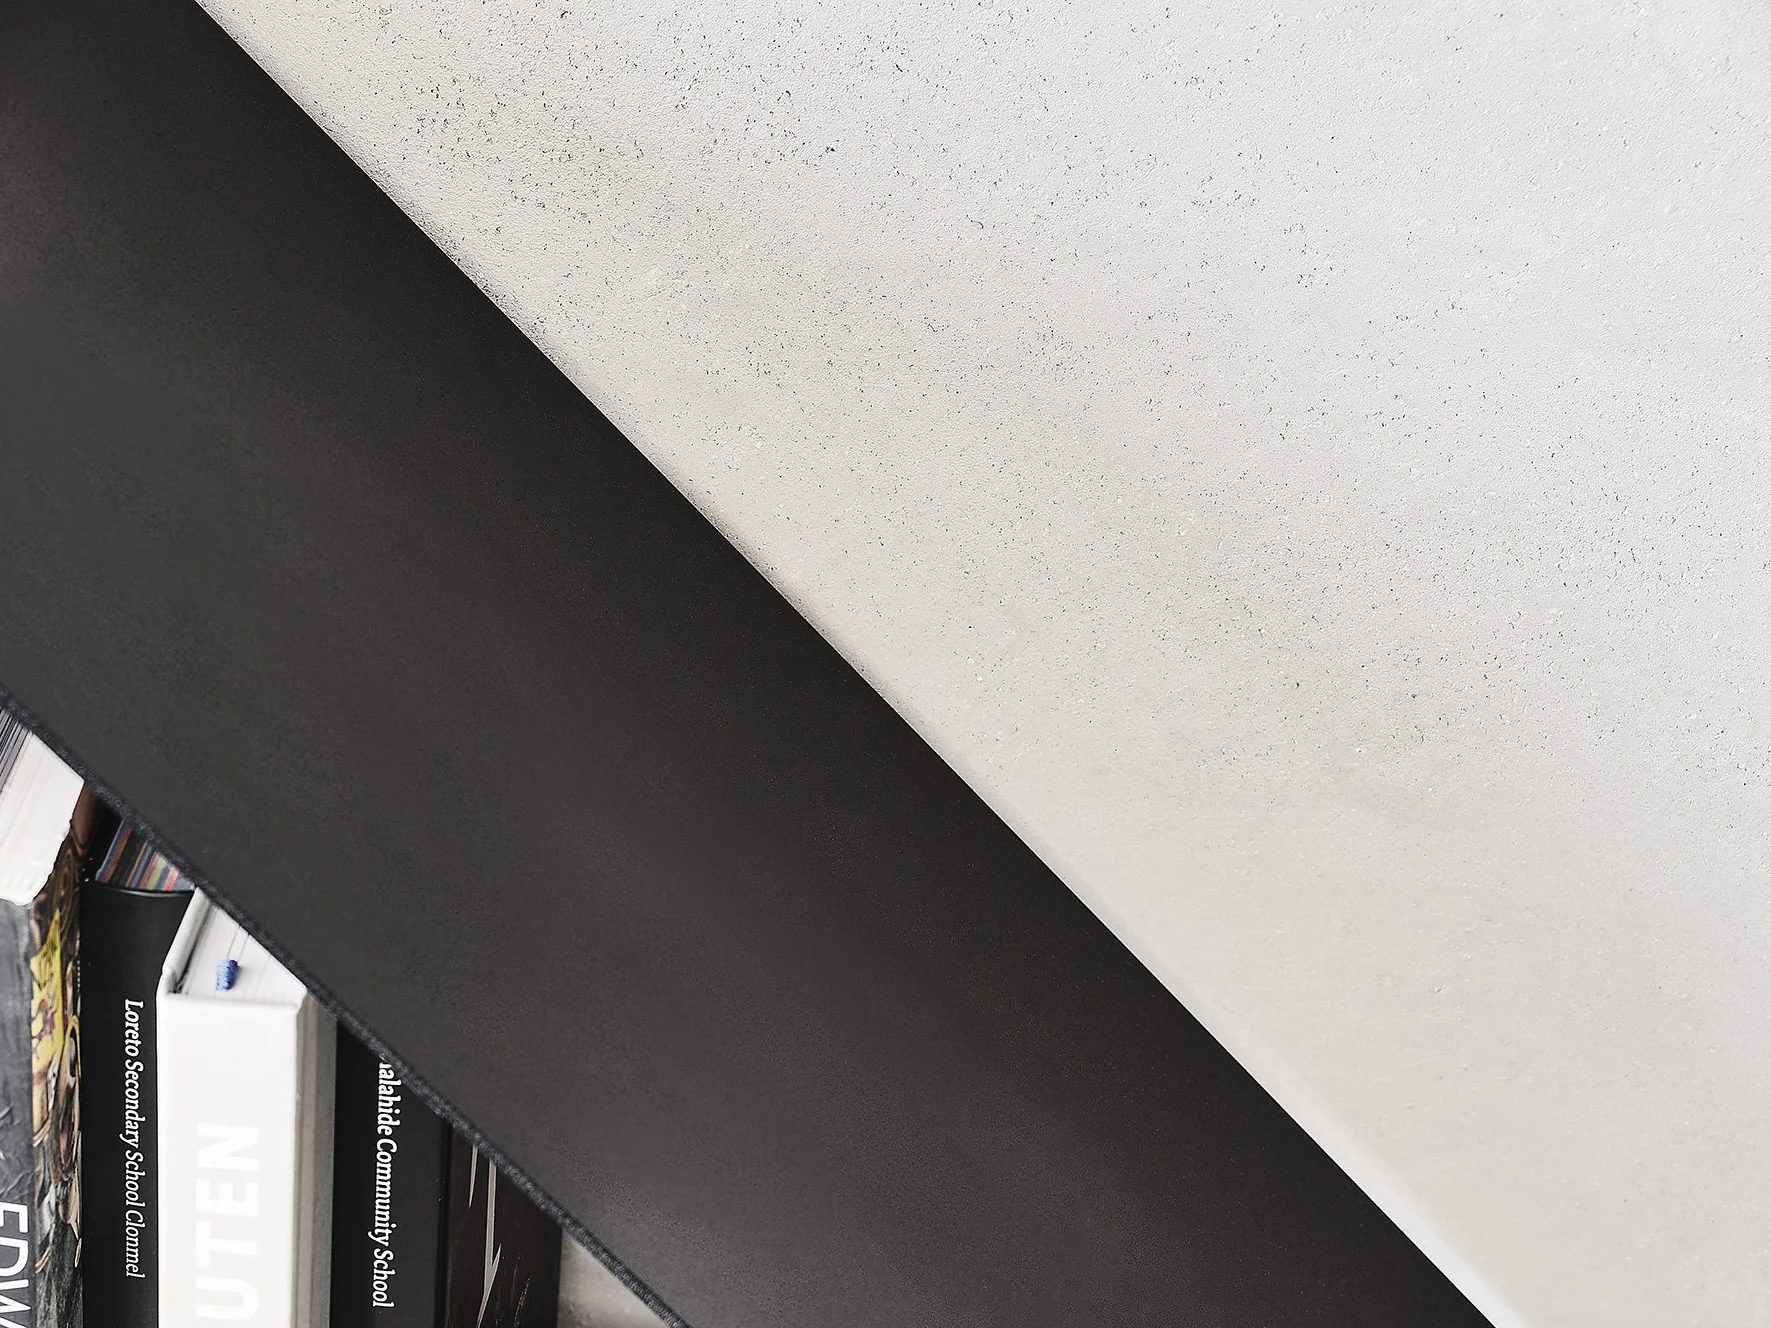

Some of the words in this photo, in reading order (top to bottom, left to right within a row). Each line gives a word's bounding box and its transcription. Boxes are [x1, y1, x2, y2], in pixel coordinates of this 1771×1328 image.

[124, 998, 144, 1057] Loreto
[119, 1057, 144, 1149] Secondary
[124, 1148, 145, 1206] School
[367, 1137, 398, 1247] Community
[124, 1207, 146, 1278] Clonmel
[371, 1247, 395, 1309] School
